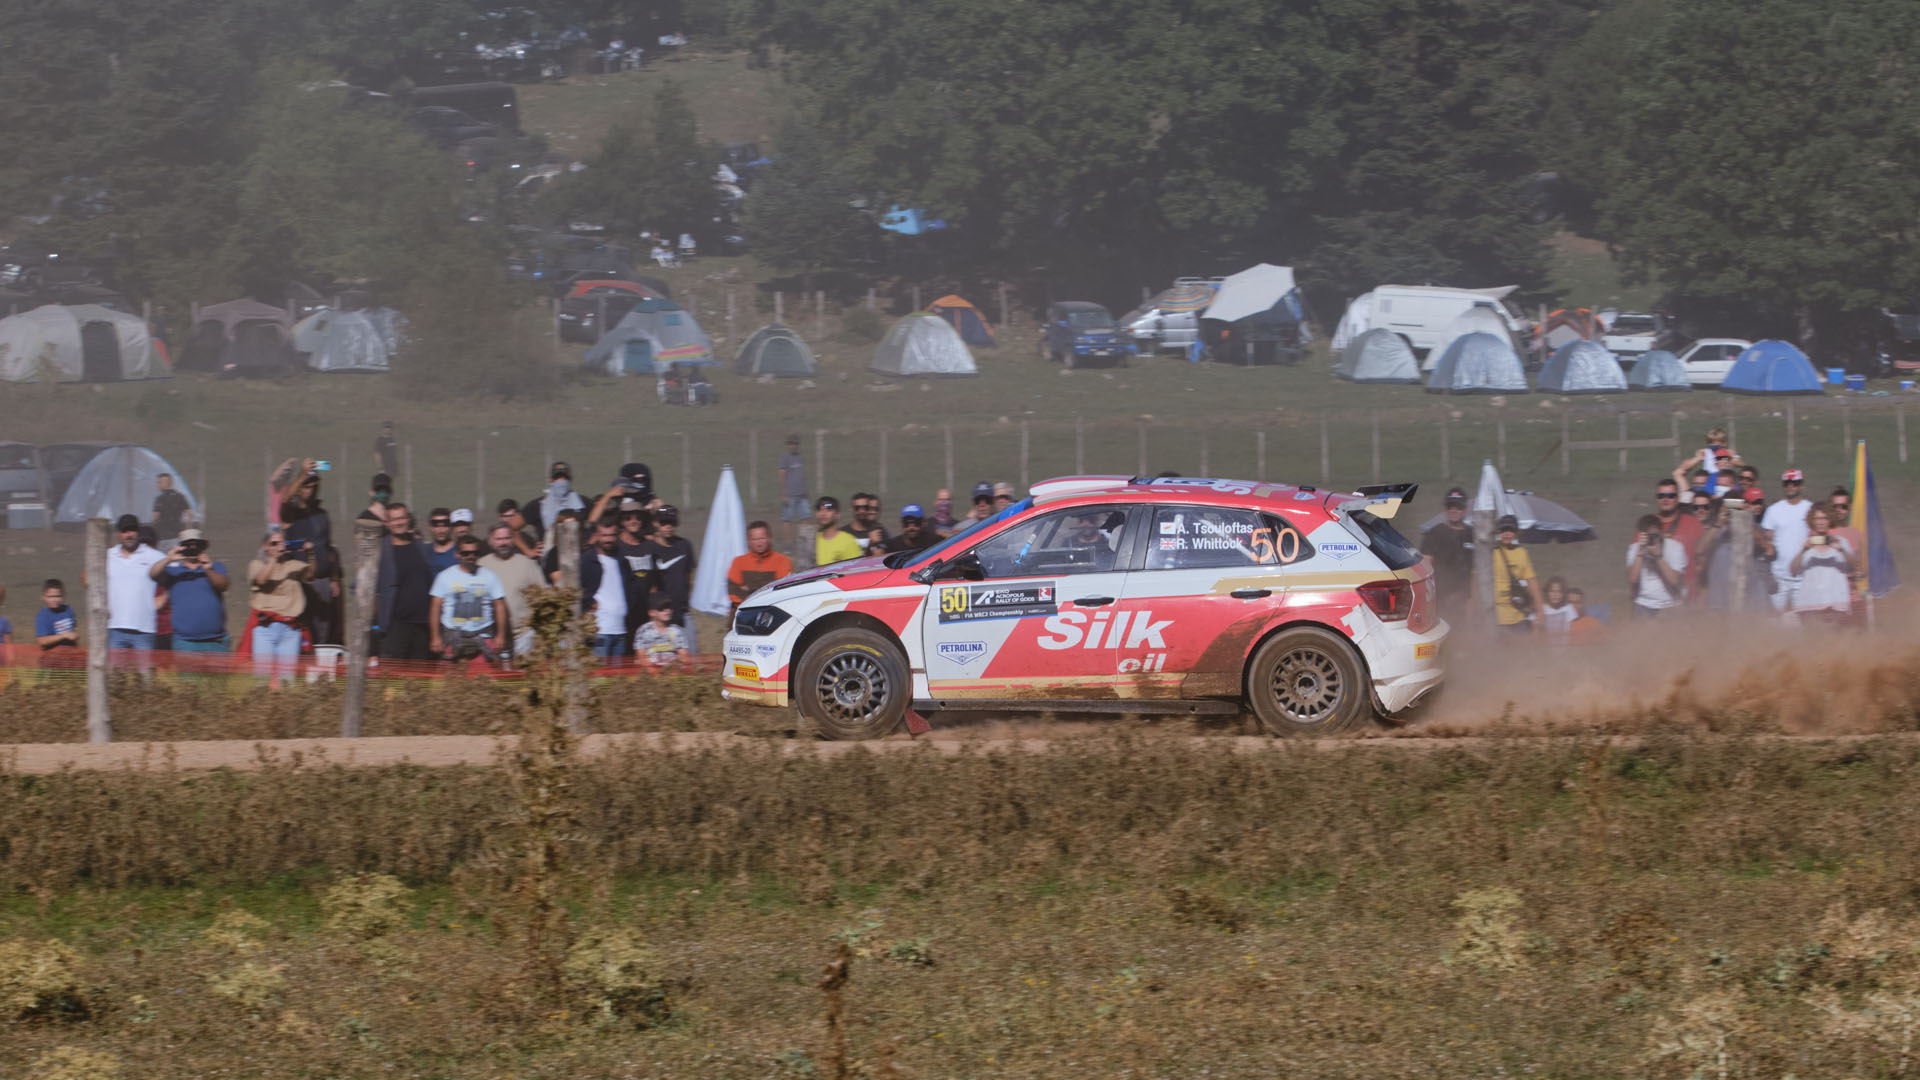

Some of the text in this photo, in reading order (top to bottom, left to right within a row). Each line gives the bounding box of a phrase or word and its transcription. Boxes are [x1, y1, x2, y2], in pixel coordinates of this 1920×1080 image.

[1176, 522, 1254, 535] A. Tsouloftas
[1176, 537, 1243, 550] R. Whittock
[1250, 527, 1299, 563] 50
[1321, 543, 1358, 552] PETROLINA
[941, 586, 967, 613] 50
[989, 609, 1024, 617] Championship
[1037, 610, 1176, 650] Silk
[940, 643, 983, 653] PETROLINA
[1118, 653, 1168, 673] oil
